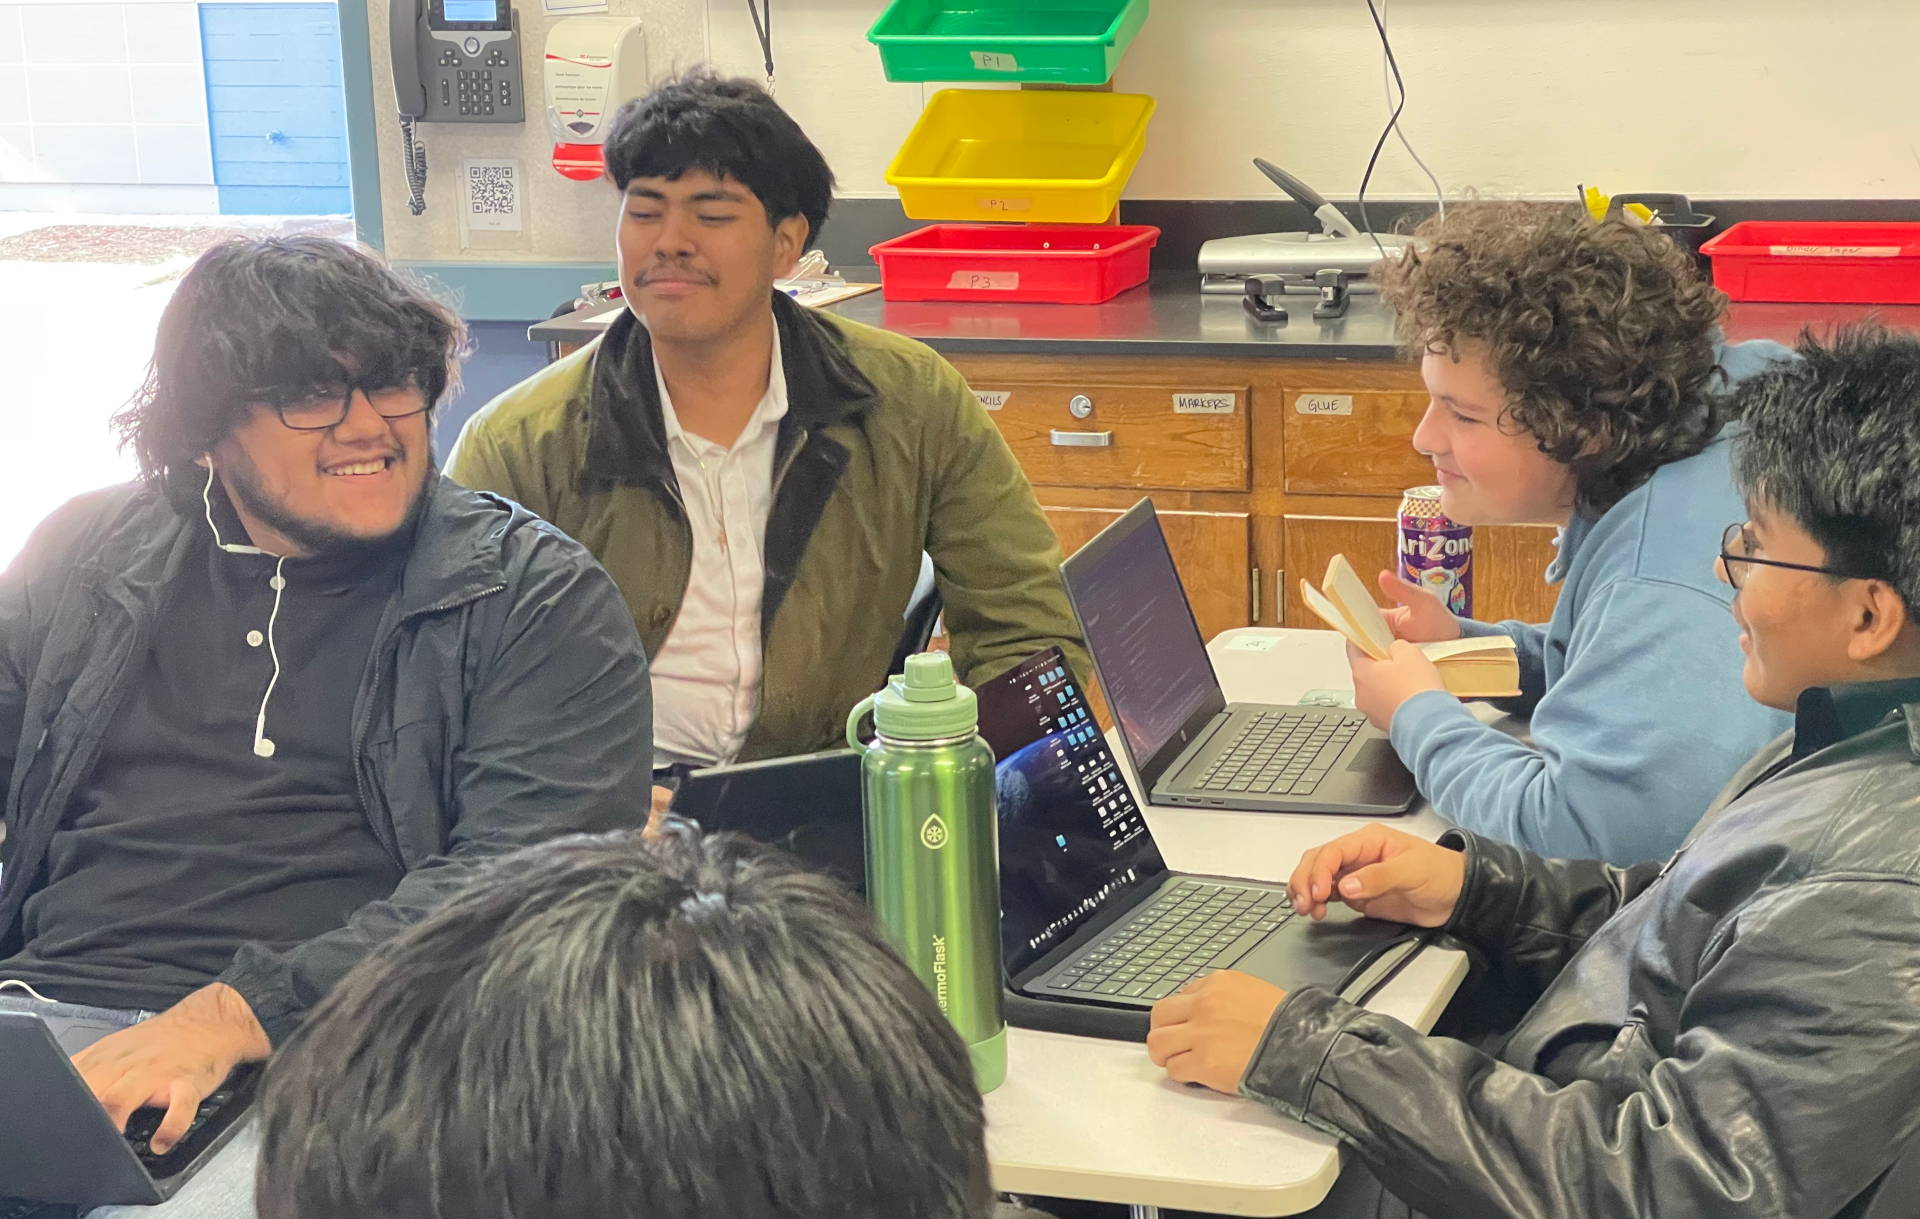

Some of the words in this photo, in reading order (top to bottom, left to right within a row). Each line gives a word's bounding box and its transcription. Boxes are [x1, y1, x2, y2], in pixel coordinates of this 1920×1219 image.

[982, 54, 1000, 68] P1
[990, 199, 1009, 211] P2
[970, 274, 991, 289] P3
[976, 395, 1002, 406] NCILS
[1178, 396, 1231, 410] MARKERS
[1308, 399, 1340, 413] GLUE
[932, 935, 948, 1017] ermoFlask
